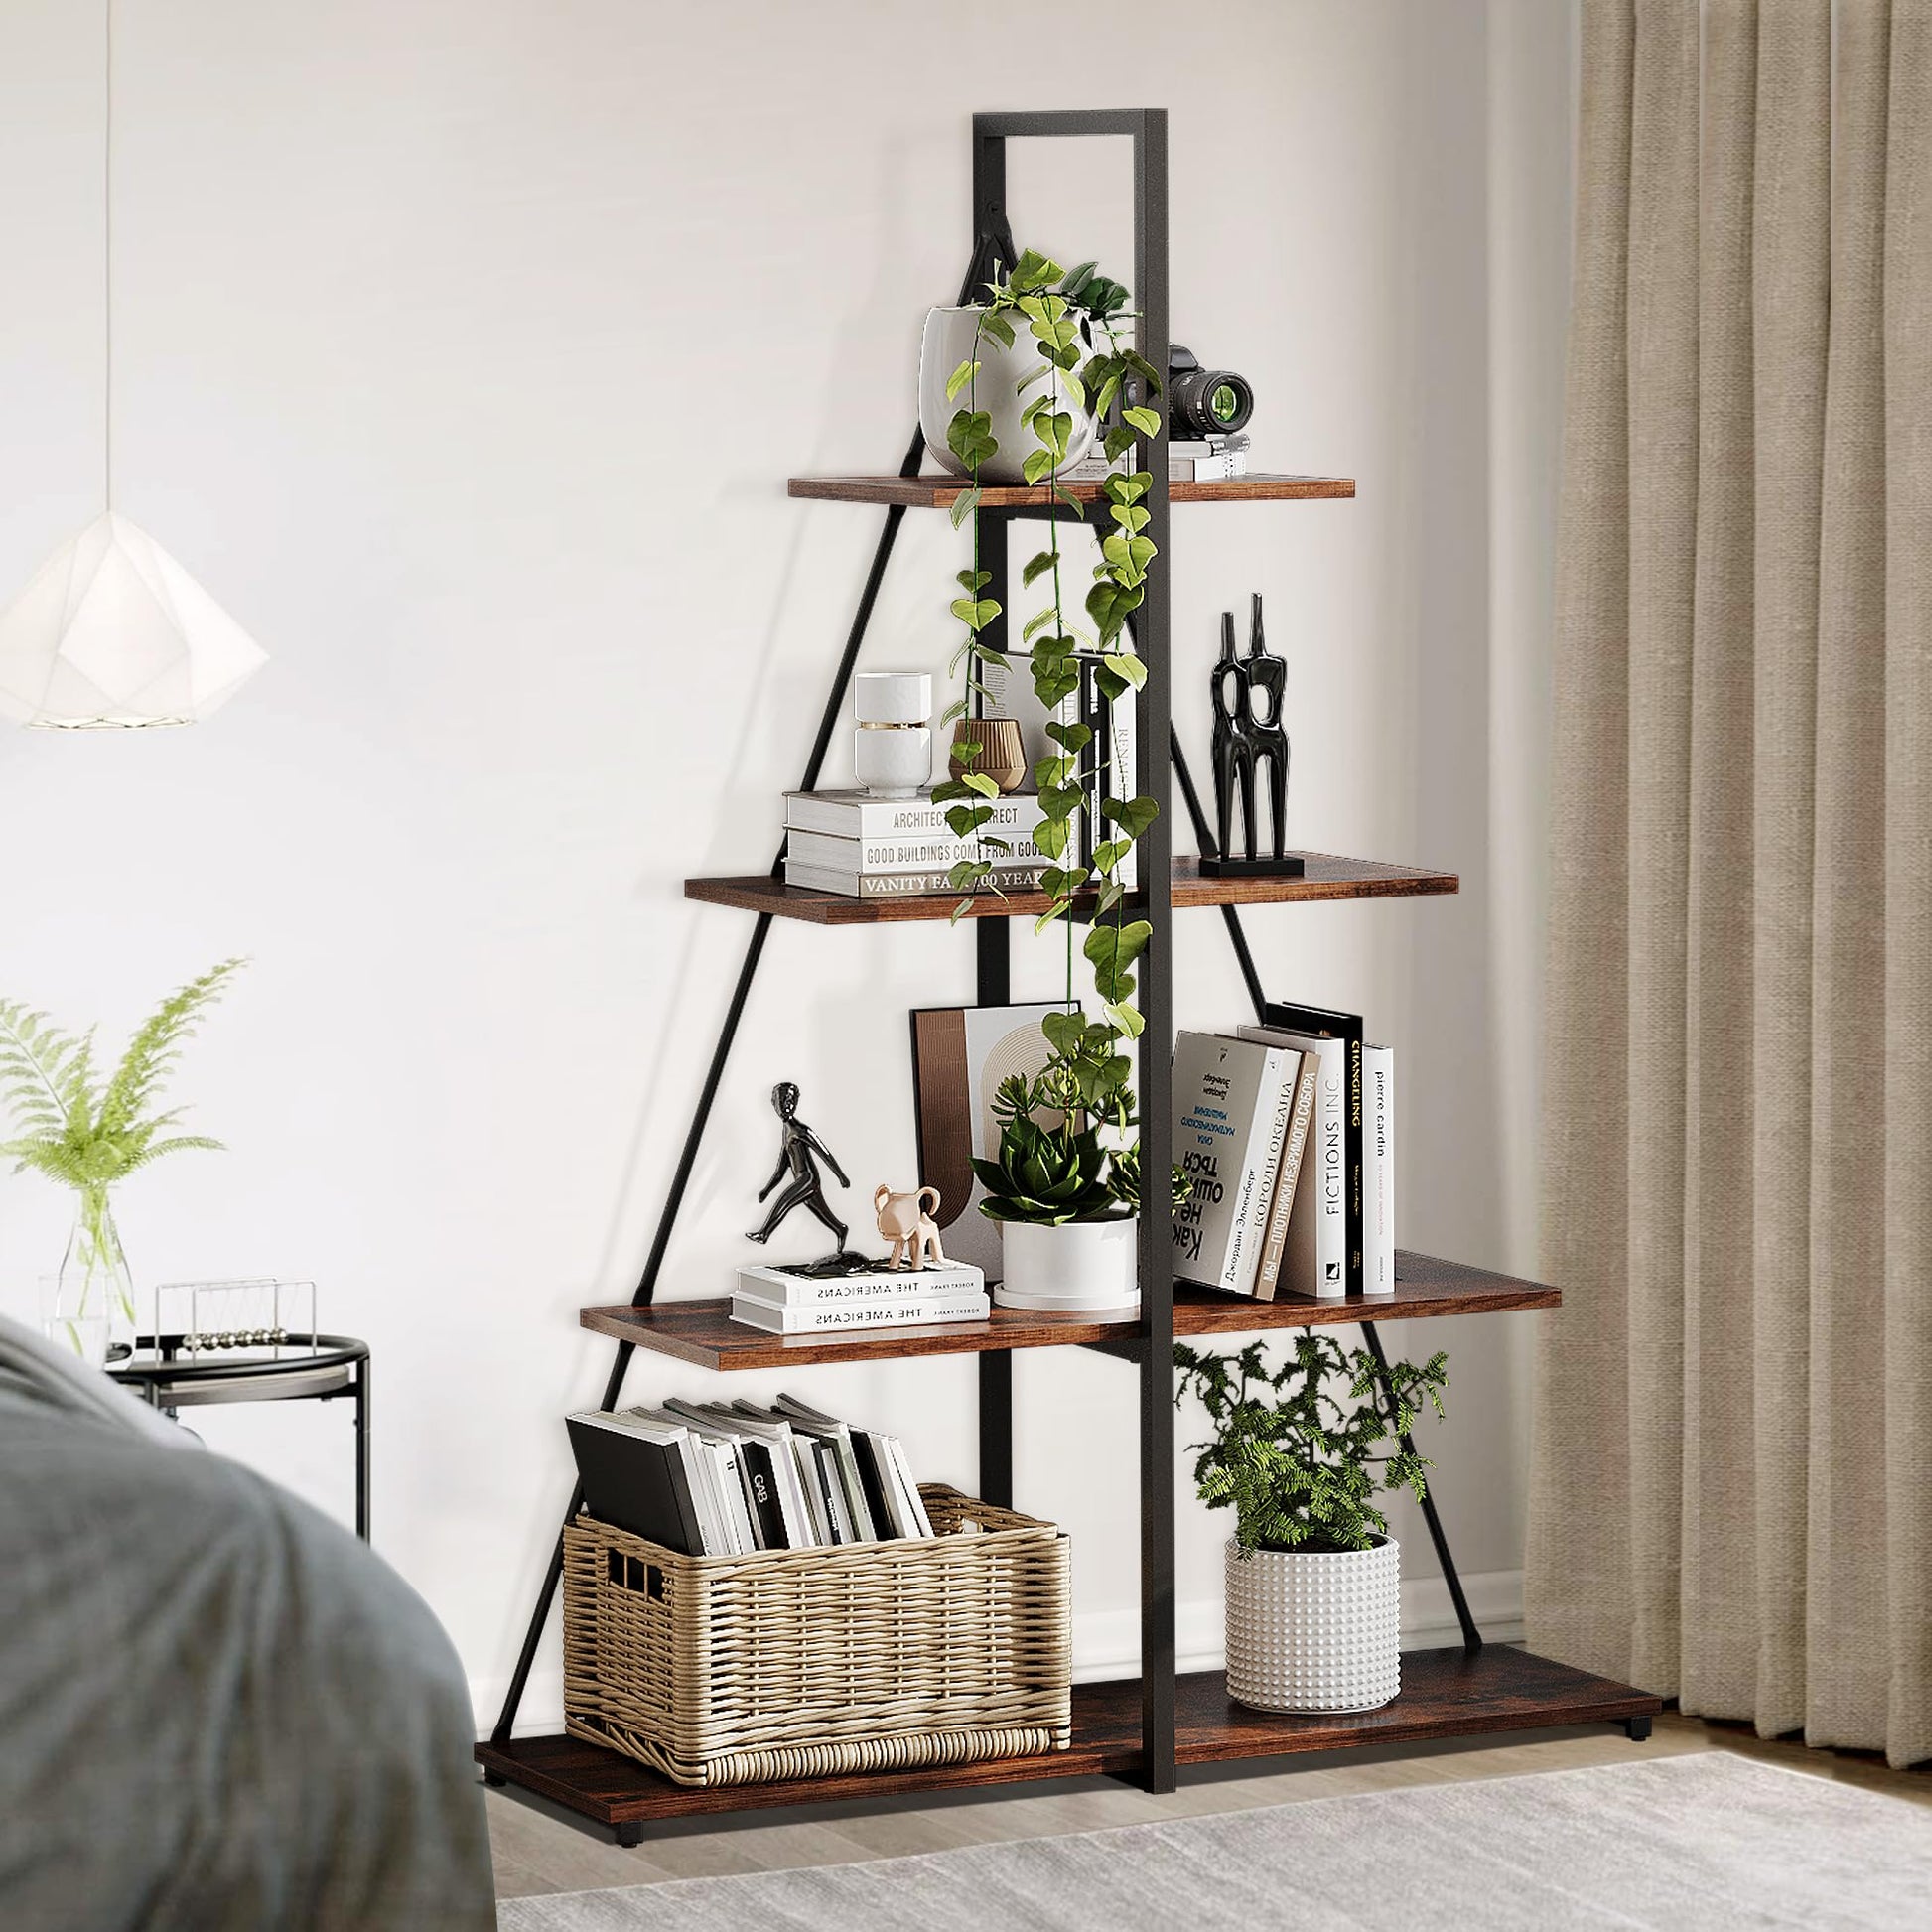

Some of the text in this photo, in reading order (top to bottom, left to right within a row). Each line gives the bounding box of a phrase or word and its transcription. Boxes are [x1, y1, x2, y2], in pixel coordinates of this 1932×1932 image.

[986, 808, 1018, 824] RECT
[866, 846, 895, 865] GOOD
[897, 844, 951, 863] BUILDINGS
[865, 876, 928, 893] VANITY
[1351, 1040, 1361, 1127] CHANGELING
[1374, 1071, 1386, 1157] pierre cardin
[1255, 1081, 1292, 1227] КОРОЛИ ОКЕАНА
[1325, 1073, 1340, 1215] FICTIONS INC.
[1182, 1150, 1218, 1178] ться
[1262, 1260, 1278, 1282] МЫ
[1271, 1182, 1293, 1243] ПЛОТНИКИ
[1284, 1117, 1307, 1183] НЕЗРИМОГО
[1297, 1072, 1315, 1116] СОБОРА
[1180, 1202, 1203, 1225] не
[1224, 1230, 1243, 1282] Джордан
[1235, 1168, 1256, 1228] Элленберг
[1173, 1224, 1203, 1261] Как
[754, 1473, 768, 1503] GAB
